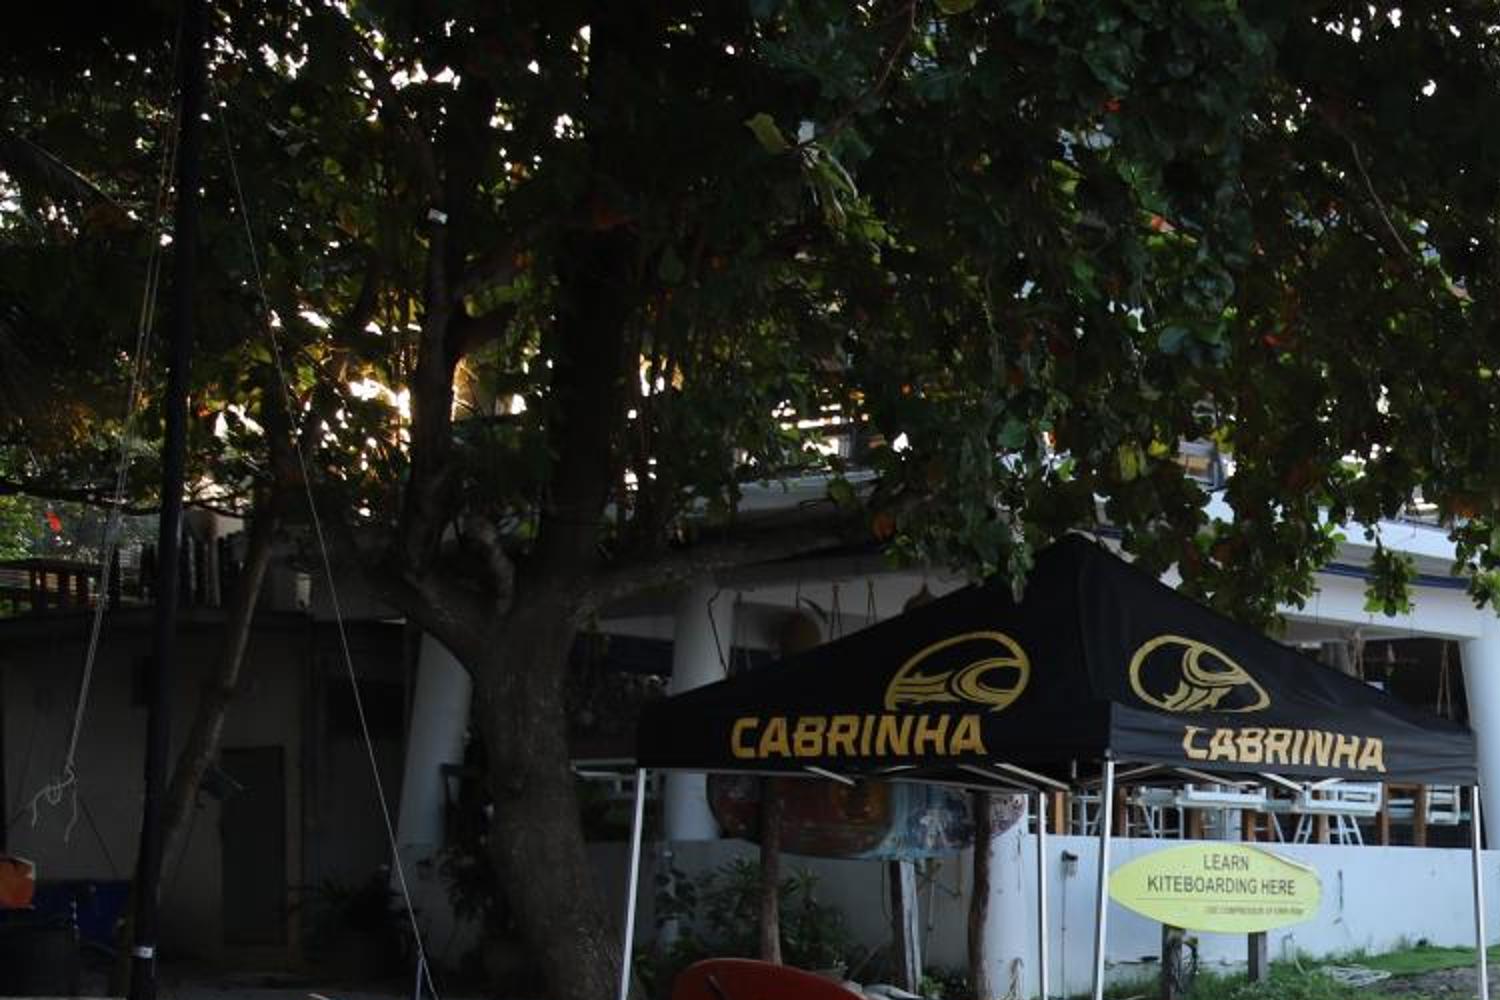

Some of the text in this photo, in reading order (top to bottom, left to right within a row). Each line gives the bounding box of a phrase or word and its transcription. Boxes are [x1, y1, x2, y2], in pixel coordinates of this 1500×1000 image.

[731, 714, 988, 758] CABRINHA
[1183, 726, 1386, 772] CABRINHA
[1203, 853, 1249, 871] LEARN
[1147, 875, 1296, 896] KITEBOARDING HERE
